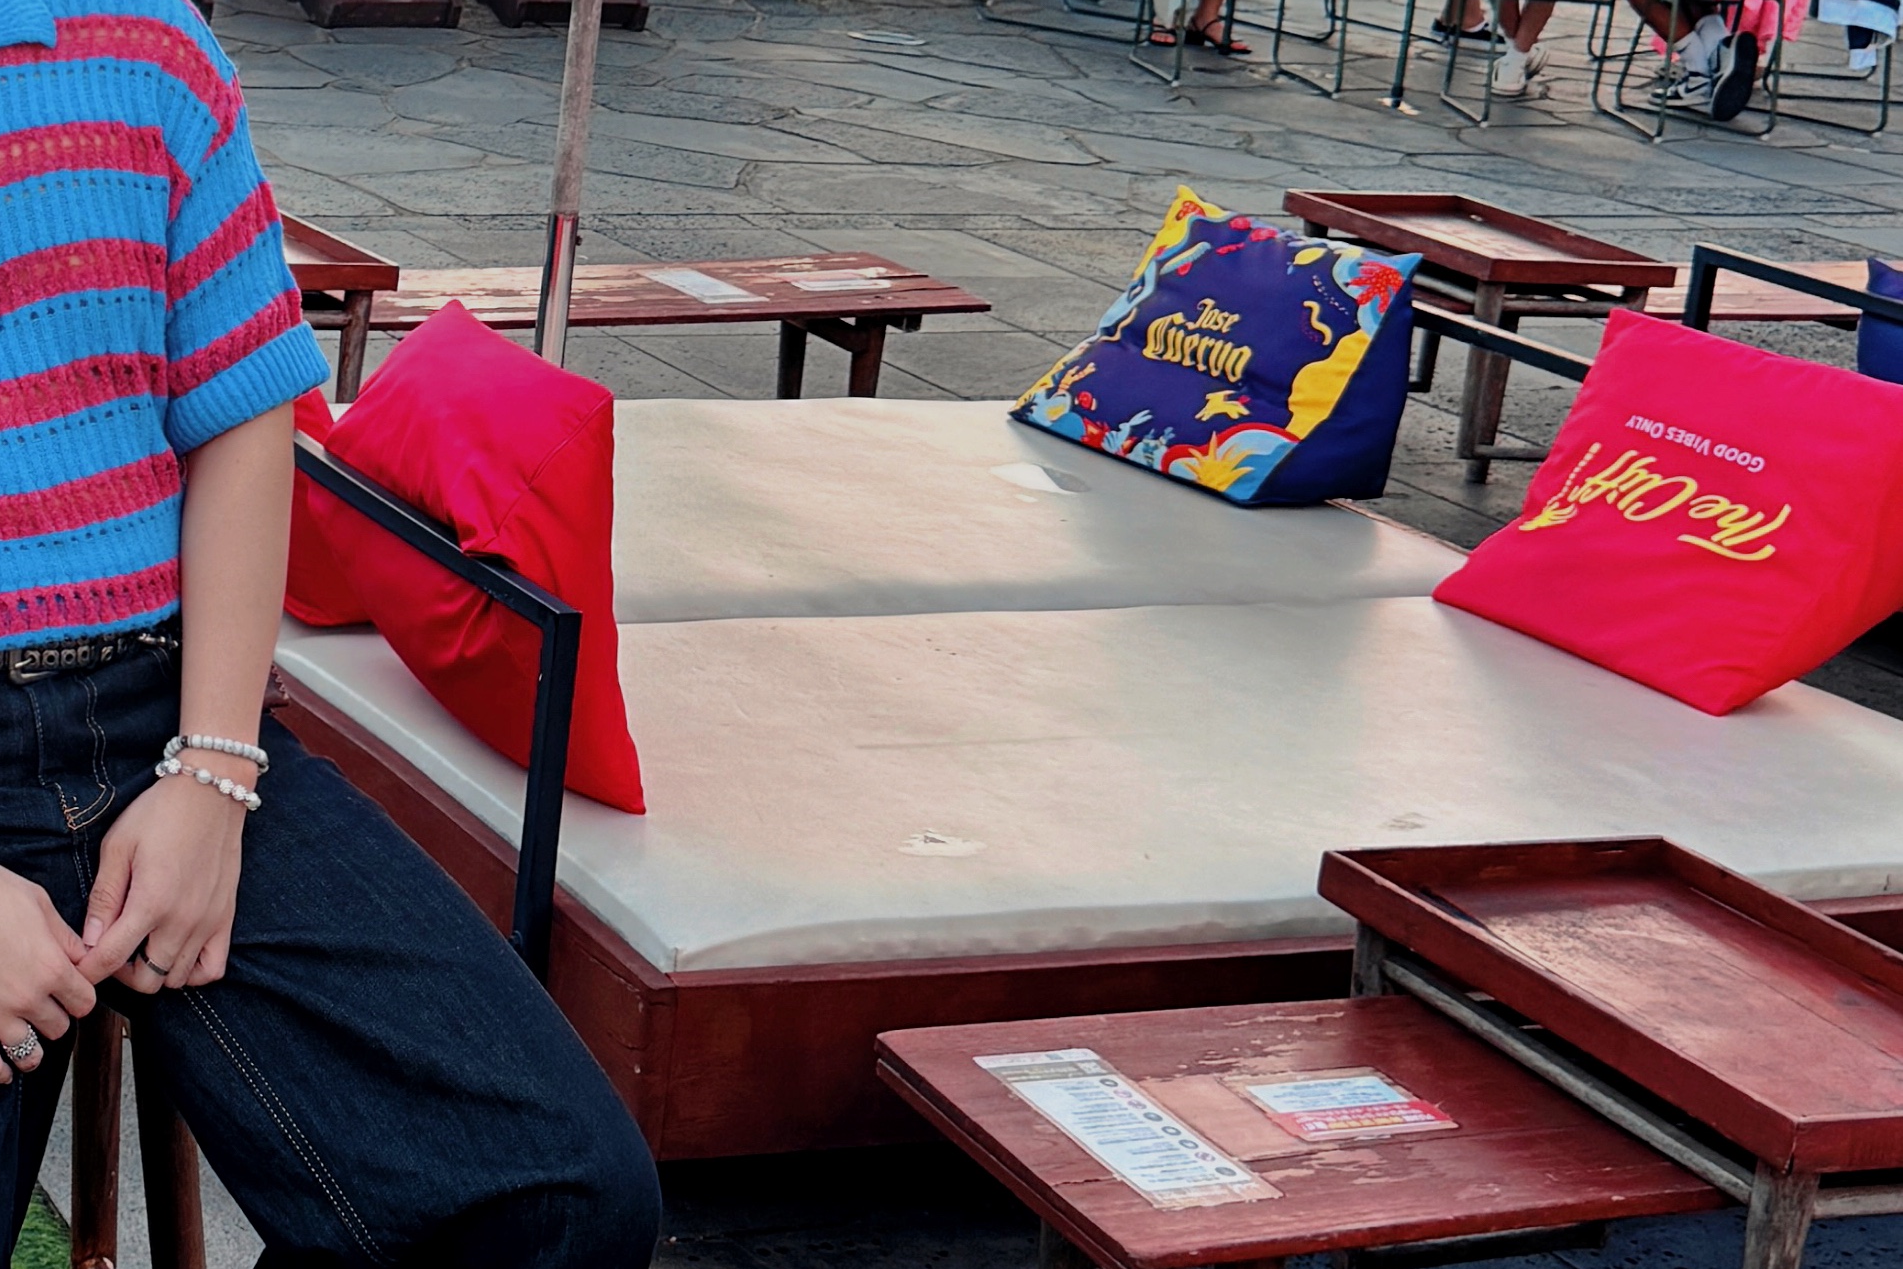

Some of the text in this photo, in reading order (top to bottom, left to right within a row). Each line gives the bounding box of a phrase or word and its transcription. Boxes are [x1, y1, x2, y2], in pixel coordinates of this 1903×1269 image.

[1143, 311, 1253, 383] Cuervo
[1567, 449, 1792, 561] The Cliff
